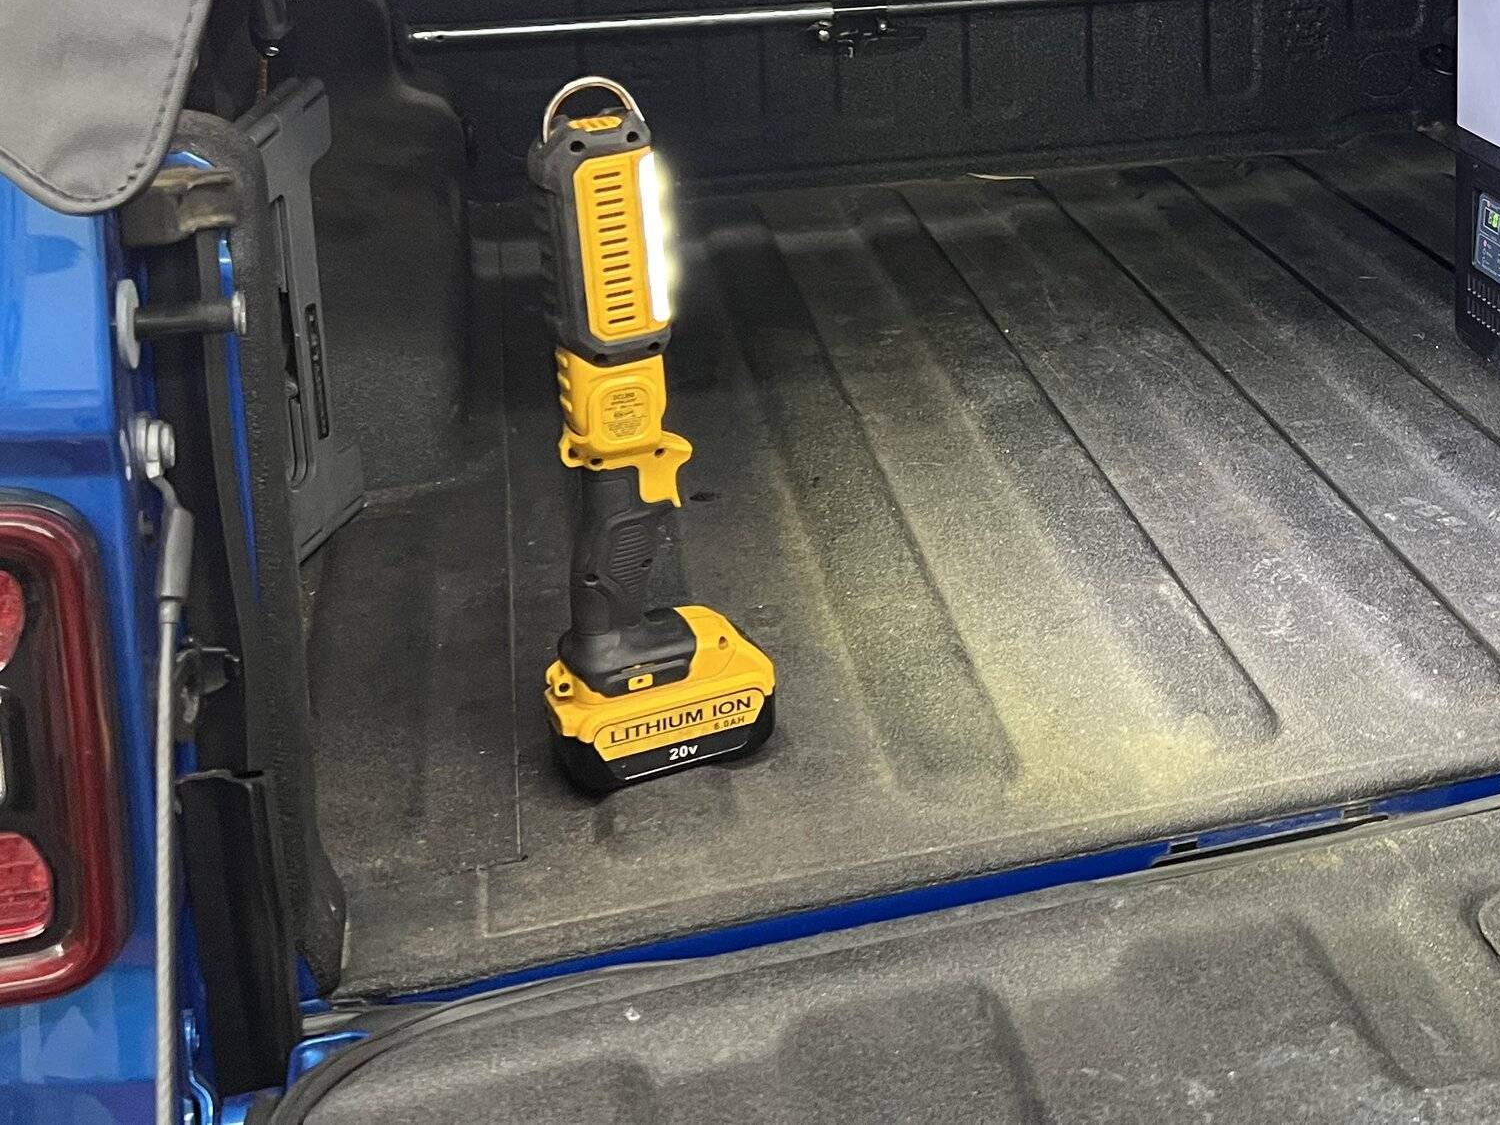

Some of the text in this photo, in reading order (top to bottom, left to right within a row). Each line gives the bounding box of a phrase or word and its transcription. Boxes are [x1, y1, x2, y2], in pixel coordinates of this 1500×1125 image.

[610, 696, 751, 744] LITHIUM ION
[669, 745, 698, 761] 20v
